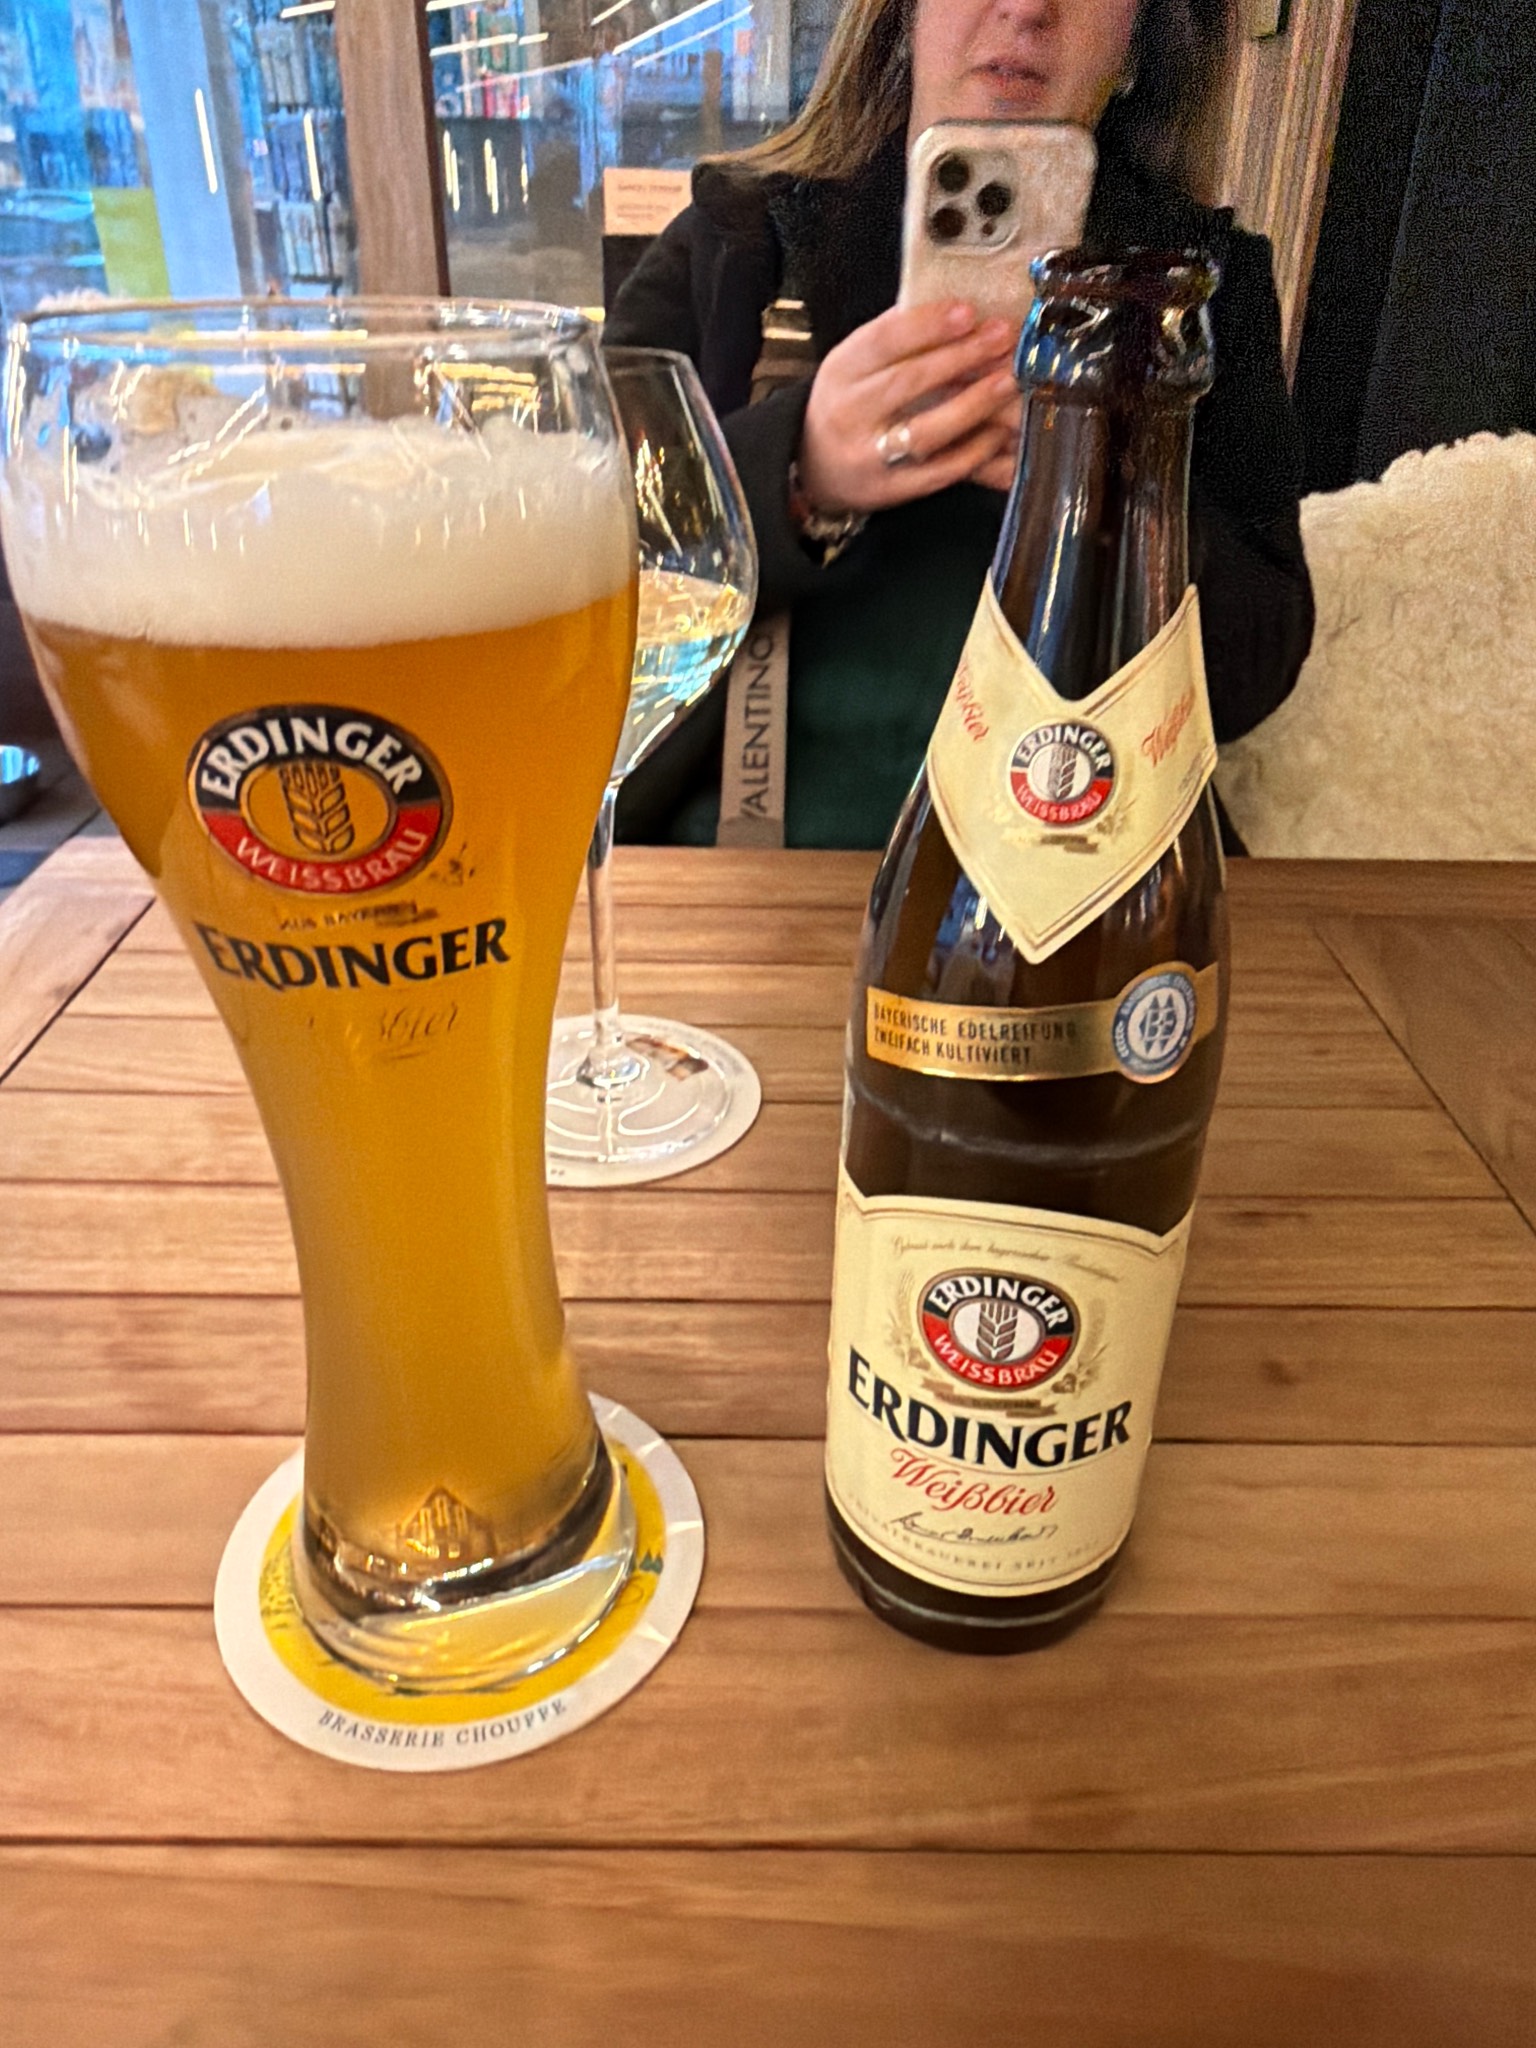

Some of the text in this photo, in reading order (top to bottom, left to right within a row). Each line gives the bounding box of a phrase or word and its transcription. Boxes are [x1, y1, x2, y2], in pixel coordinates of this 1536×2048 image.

[201, 716, 423, 800] ERDINGER
[1017, 724, 1112, 772] ERDINGER
[194, 917, 511, 993] ERDINGER
[873, 1003, 947, 1036] BAYERISCHE
[936, 1041, 1031, 1063] KULTIVIERT
[928, 1276, 1070, 1328] ERDINGER
[848, 1343, 1133, 1469] ERDINGER
[890, 1448, 1057, 1516] Weißbier
[317, 1698, 567, 1748] BRASSERIE CHOUFFE
